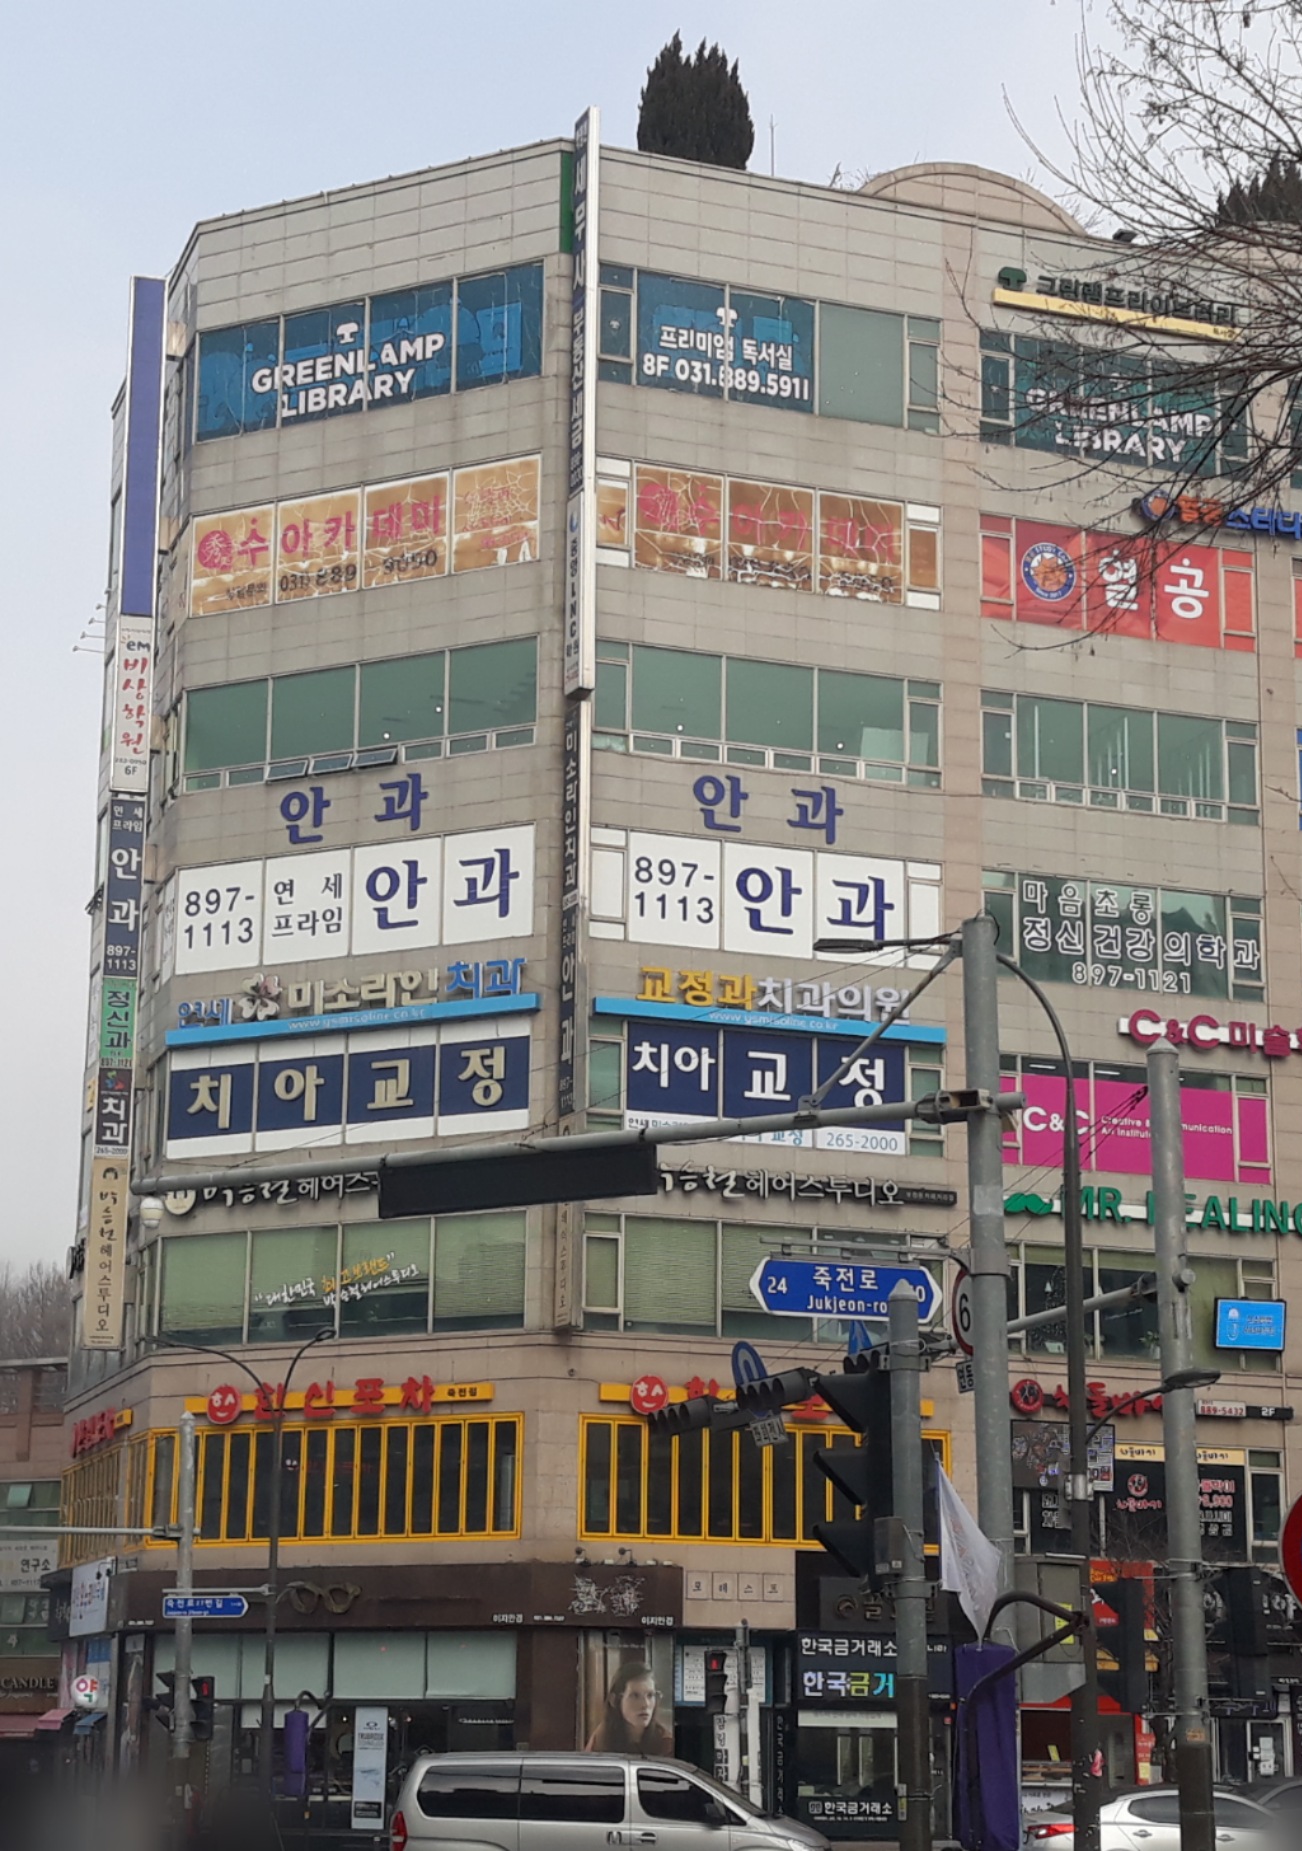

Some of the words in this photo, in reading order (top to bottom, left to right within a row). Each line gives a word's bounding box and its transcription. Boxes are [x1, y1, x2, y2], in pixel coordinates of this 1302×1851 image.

[251, 331, 447, 394] GREENLAMP
[660, 325, 734, 361] 프리미엄
[742, 339, 793, 371] 독서실
[280, 369, 416, 418] LIBRARY
[643, 354, 669, 377] 8F
[675, 358, 809, 400] 031.889.5911
[120, 657, 149, 755] 비상학원
[124, 765, 137, 776] 6F
[279, 772, 429, 845] 안과
[692, 774, 844, 845] 안과
[112, 819, 143, 833] 프라임
[634, 856, 715, 888] 897-
[108, 847, 142, 932] 안과
[185, 886, 256, 918] 897-
[273, 872, 343, 906] 연세
[365, 848, 521, 931] 안과
[735, 865, 895, 942] 안과
[1022, 880, 1154, 926] 마음초롱
[271, 906, 344, 939] 프라임
[634, 891, 715, 924] 1113
[184, 917, 254, 950] 1113
[1022, 916, 1261, 971] 정신건강의학과
[106, 945, 136, 957] 897-
[107, 958, 137, 971] 1113
[177, 997, 232, 1030] 연세
[445, 957, 527, 999] 치과
[1072, 962, 1192, 994] 897-1121
[106, 990, 132, 1050] 정신과
[186, 1045, 506, 1130] 치아교정
[631, 1040, 886, 1109] 치아교정
[101, 1096, 127, 1145] 치과
[1022, 1106, 1090, 1136] C&C
[825, 1131, 899, 1153] 265-2000
[766, 1276, 788, 1295] 24
[812, 1264, 879, 1293] 죽전로
[806, 1294, 888, 1314] Jukjeon-ro
[253, 1375, 435, 1421] 한신포차
[1260, 1406, 1275, 1417] 2F
[20, 1557, 52, 1574] 연구소
[801, 1636, 898, 1658] 한국금거래소
[1, 1676, 55, 1690] CANDLE
[75, 1677, 99, 1703] 약
[824, 1800, 893, 1816] 한국금거래소
